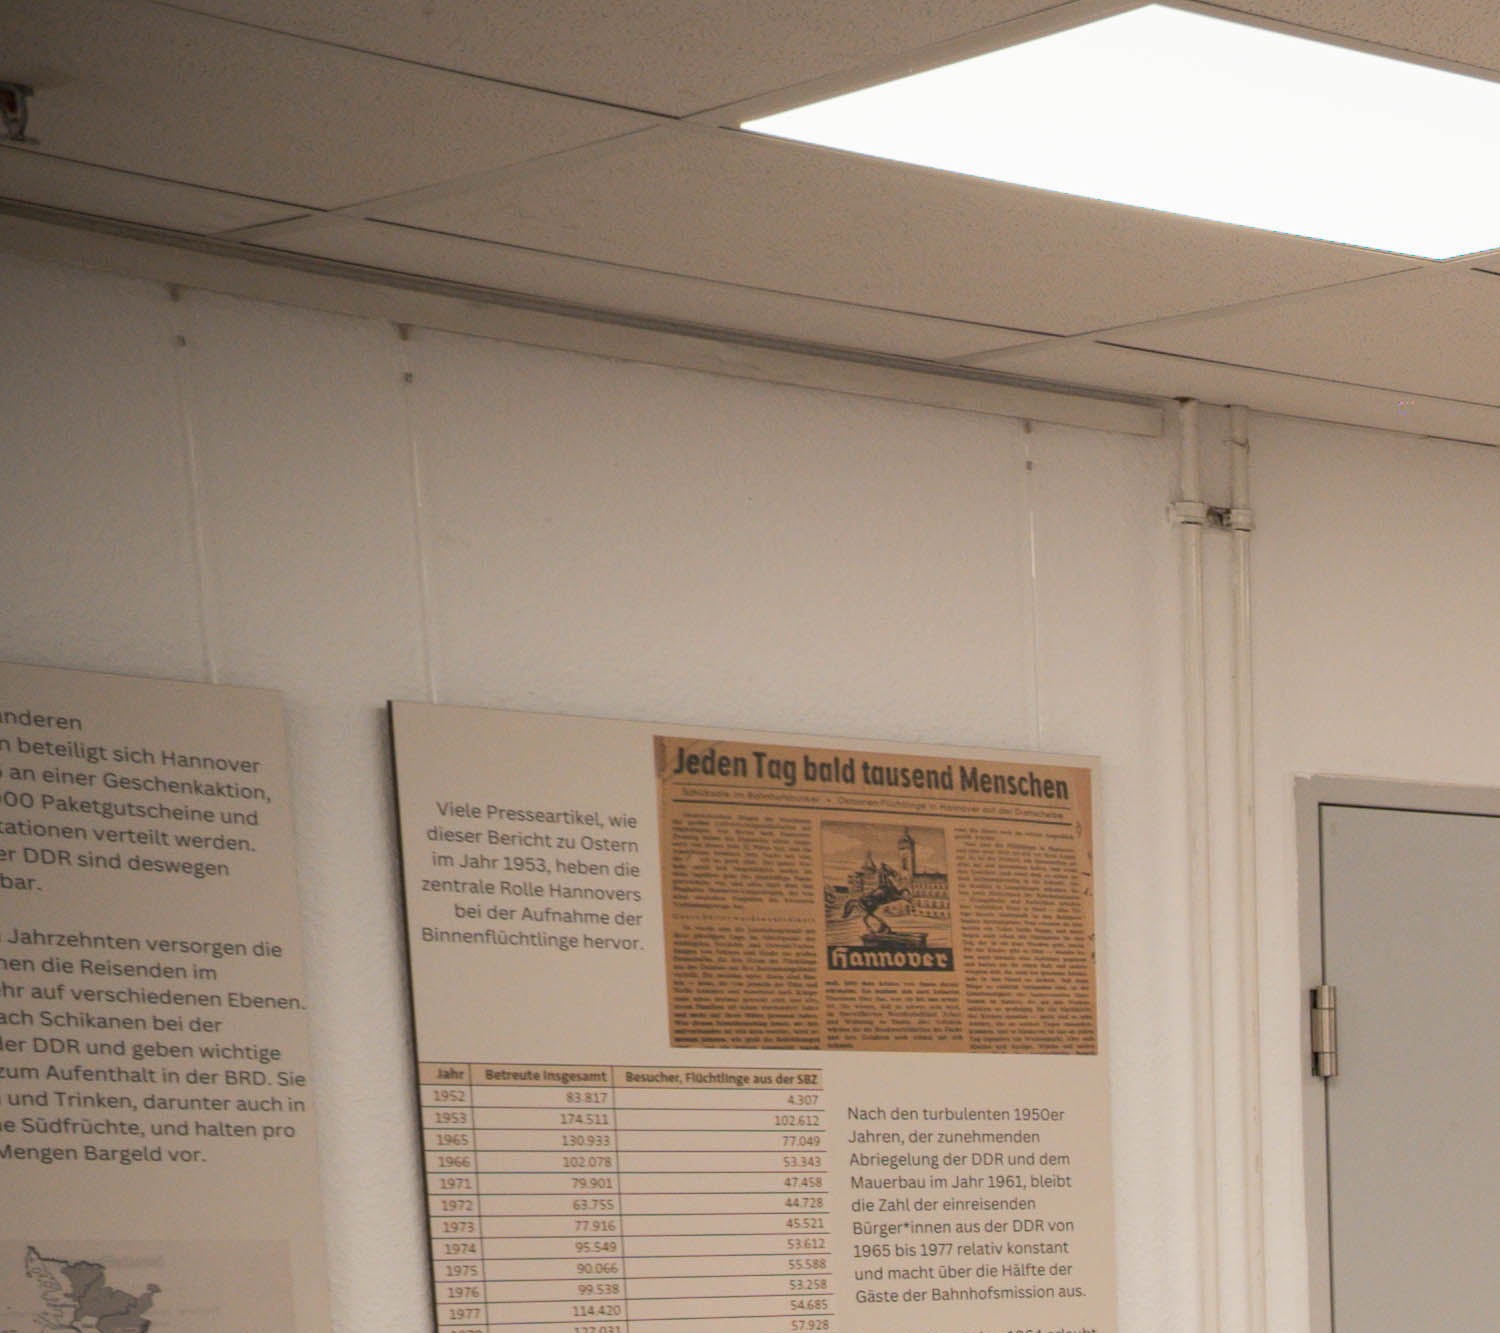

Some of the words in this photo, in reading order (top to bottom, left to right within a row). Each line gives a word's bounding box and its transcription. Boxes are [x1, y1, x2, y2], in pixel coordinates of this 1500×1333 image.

[16, 736, 108, 764] beteiligt
[112, 746, 155, 764] sich
[161, 750, 260, 773] Hannover
[9, 767, 35, 781] an
[41, 767, 96, 786] einer
[102, 771, 271, 803] Geschenkaktion,
[673, 746, 747, 777] Jeden
[752, 751, 796, 787] Tag
[803, 754, 855, 784] bald
[861, 761, 954, 790] tausend
[958, 765, 1068, 800] Menschen
[435, 801, 481, 818] Viele
[486, 804, 604, 828] Presseartikel,
[608, 813, 637, 828] wie
[426, 825, 482, 843] dieser
[487, 829, 552, 848] Bericht
[556, 836, 575, 849] zu
[580, 835, 638, 852] Ostern
[22, 847, 72, 865] DDR
[77, 851, 121, 869] sind
[127, 854, 229, 879] deswegen
[431, 850, 454, 866] im
[458, 853, 499, 868] Jahr
[503, 856, 551, 874] 1953,
[555, 858, 609, 875] heben
[613, 862, 640, 877] die
[421, 879, 495, 894] zentrale
[499, 880, 544, 896] Rolle
[548, 883, 641, 902] Hannovers
[454, 903, 481, 918] bei
[486, 904, 517, 920] der
[520, 906, 609, 925] Aufnahme
[613, 911, 642, 926] der
[7, 928, 140, 950] Jahrzehnten
[145, 939, 247, 959] versorgen
[251, 940, 282, 957] die
[421, 926, 578, 951] Binnenflüchtlinge
[583, 933, 644, 950] hervor.
[832, 947, 948, 969] Hannover
[31, 983, 65, 1000] auf
[70, 987, 221, 1006] verschiedenen
[227, 991, 306, 1010] Ebenen.
[437, 1068, 464, 1081] Jahr
[485, 1070, 540, 1083] Betreute
[625, 1072, 683, 1085] Besucher,
[686, 1072, 751, 1088] Flüchtlinge
[754, 1075, 773, 1085] aus
[775, 1073, 794, 1085] der
[433, 1090, 465, 1103] 1952
[436, 1112, 466, 1124] 1953
[847, 1106, 886, 1120] Nach
[889, 1107, 918, 1120] den
[922, 1106, 1009, 1120] turbulenten
[1013, 1107, 1064, 1121] 1950er
[849, 1152, 939, 1169] Abriegelung
[942, 1152, 967, 1166] der
[971, 1152, 1003, 1165] DDR
[1007, 1152, 1035, 1166] und
[1038, 1152, 1070, 1165] dem
